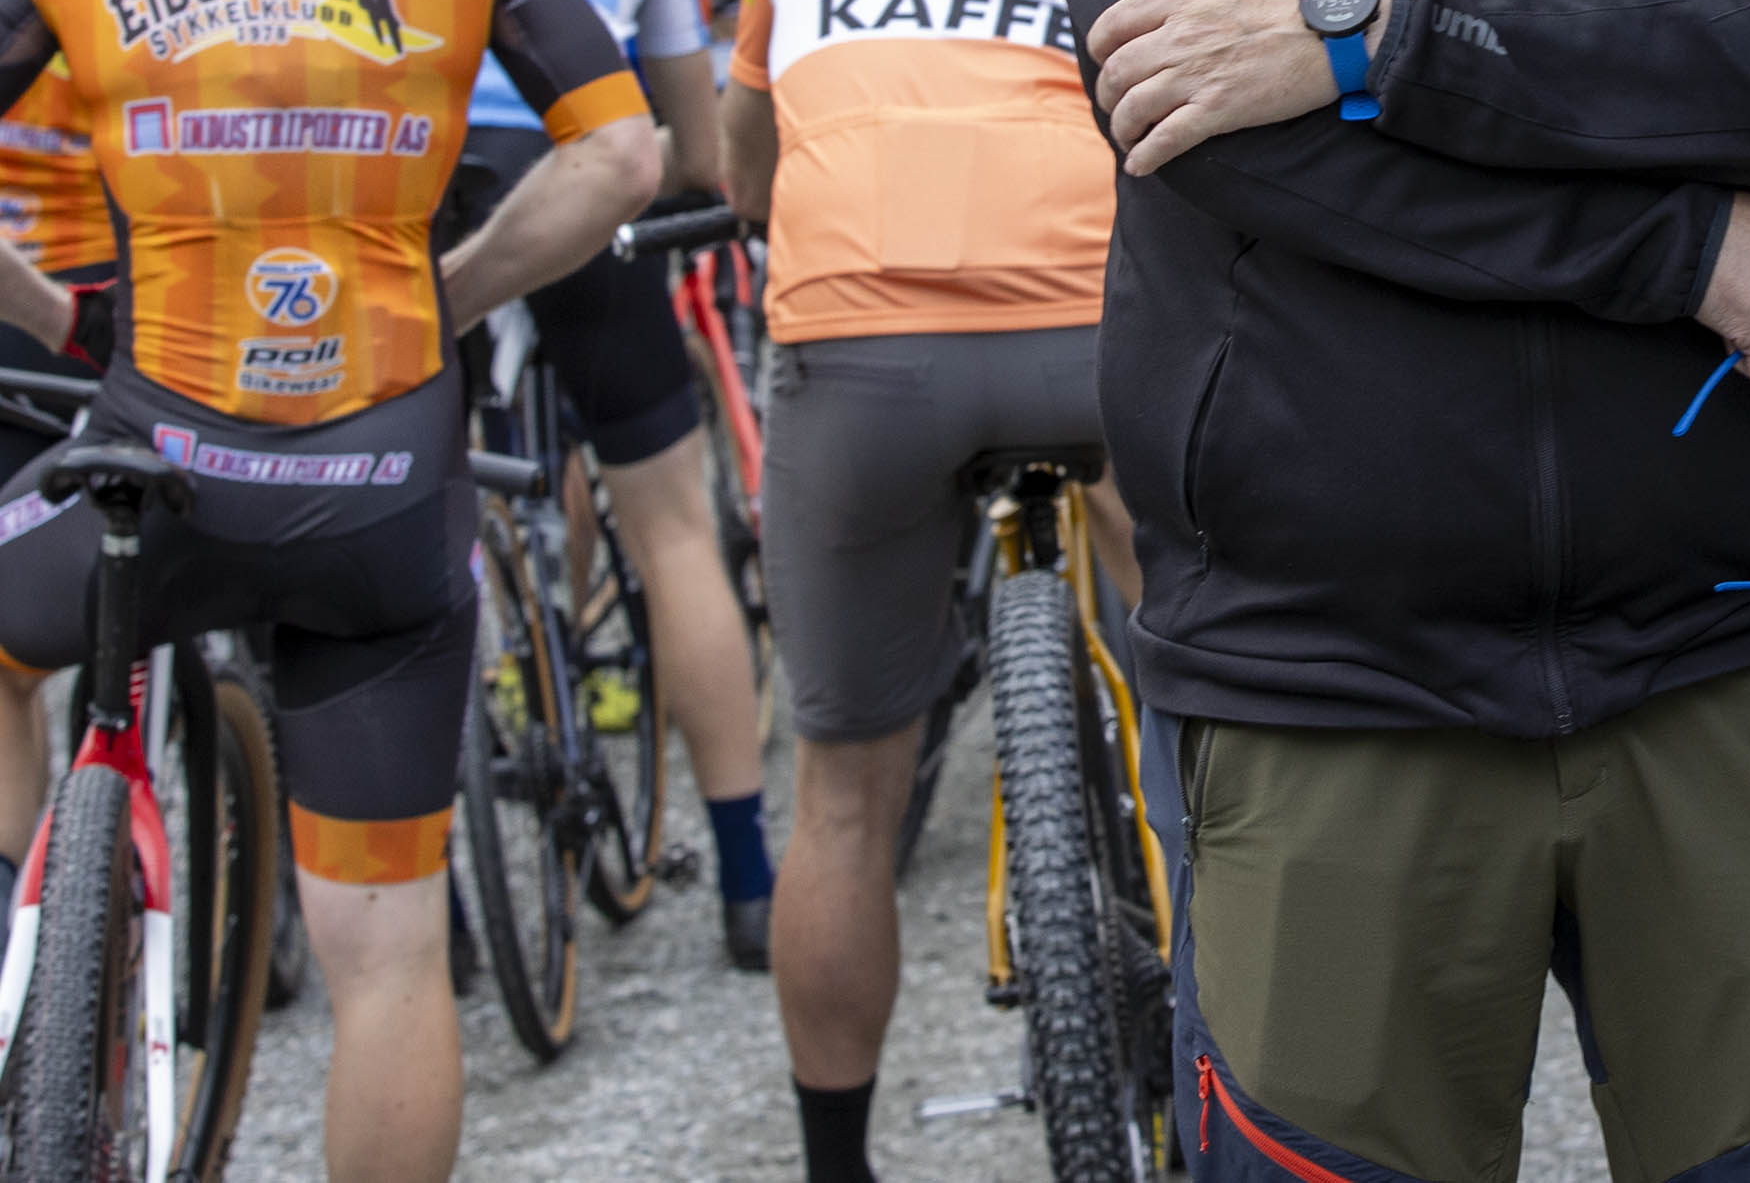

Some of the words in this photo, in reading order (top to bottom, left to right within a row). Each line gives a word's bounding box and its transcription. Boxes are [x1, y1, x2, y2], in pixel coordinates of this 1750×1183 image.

[179, 111, 388, 152] INDUSTRIPORTER
[393, 116, 430, 153] AS
[264, 278, 318, 320] 76
